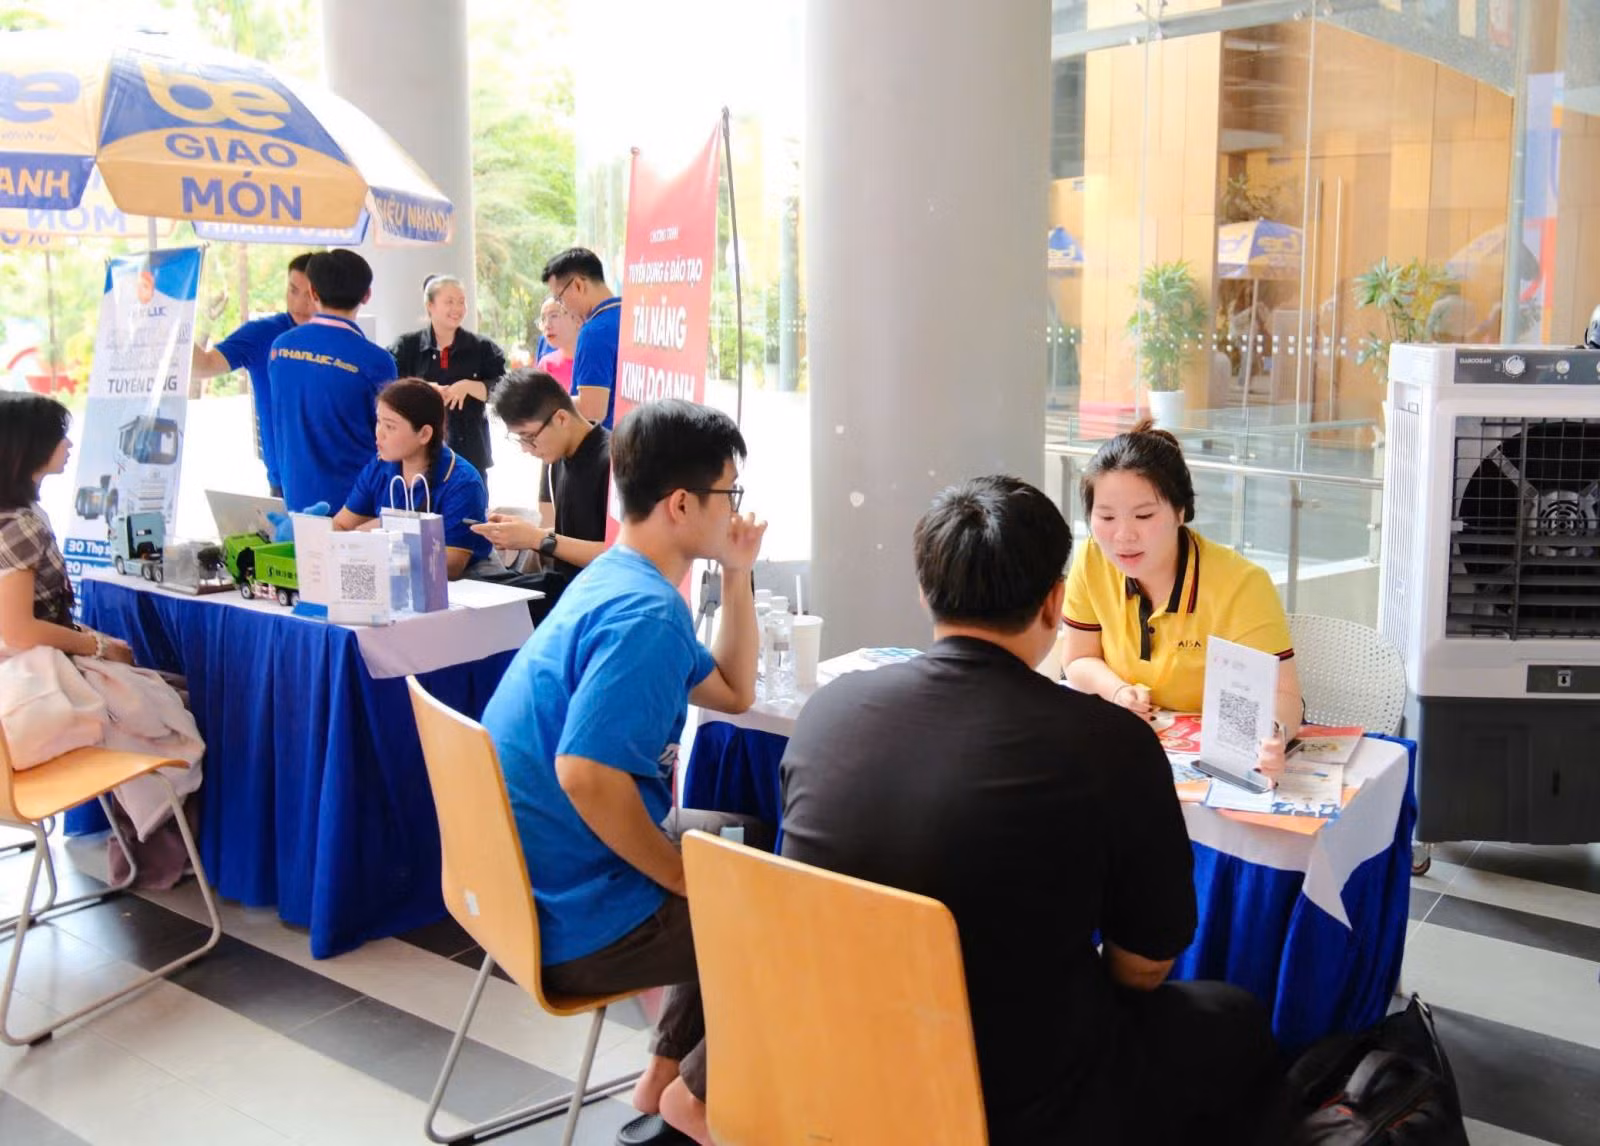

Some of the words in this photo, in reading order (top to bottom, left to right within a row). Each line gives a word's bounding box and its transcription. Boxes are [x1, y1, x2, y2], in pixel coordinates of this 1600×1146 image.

[0, 72, 81, 123] e
[140, 63, 293, 131] be
[165, 133, 298, 168] GIAO
[181, 171, 302, 221] MÓN
[687, 257, 703, 288] TẠO
[633, 295, 650, 346] TÀI
[650, 295, 688, 349] NĂNG
[621, 360, 647, 402] KINH
[646, 367, 696, 403] DOANH
[67, 540, 85, 553] 30
